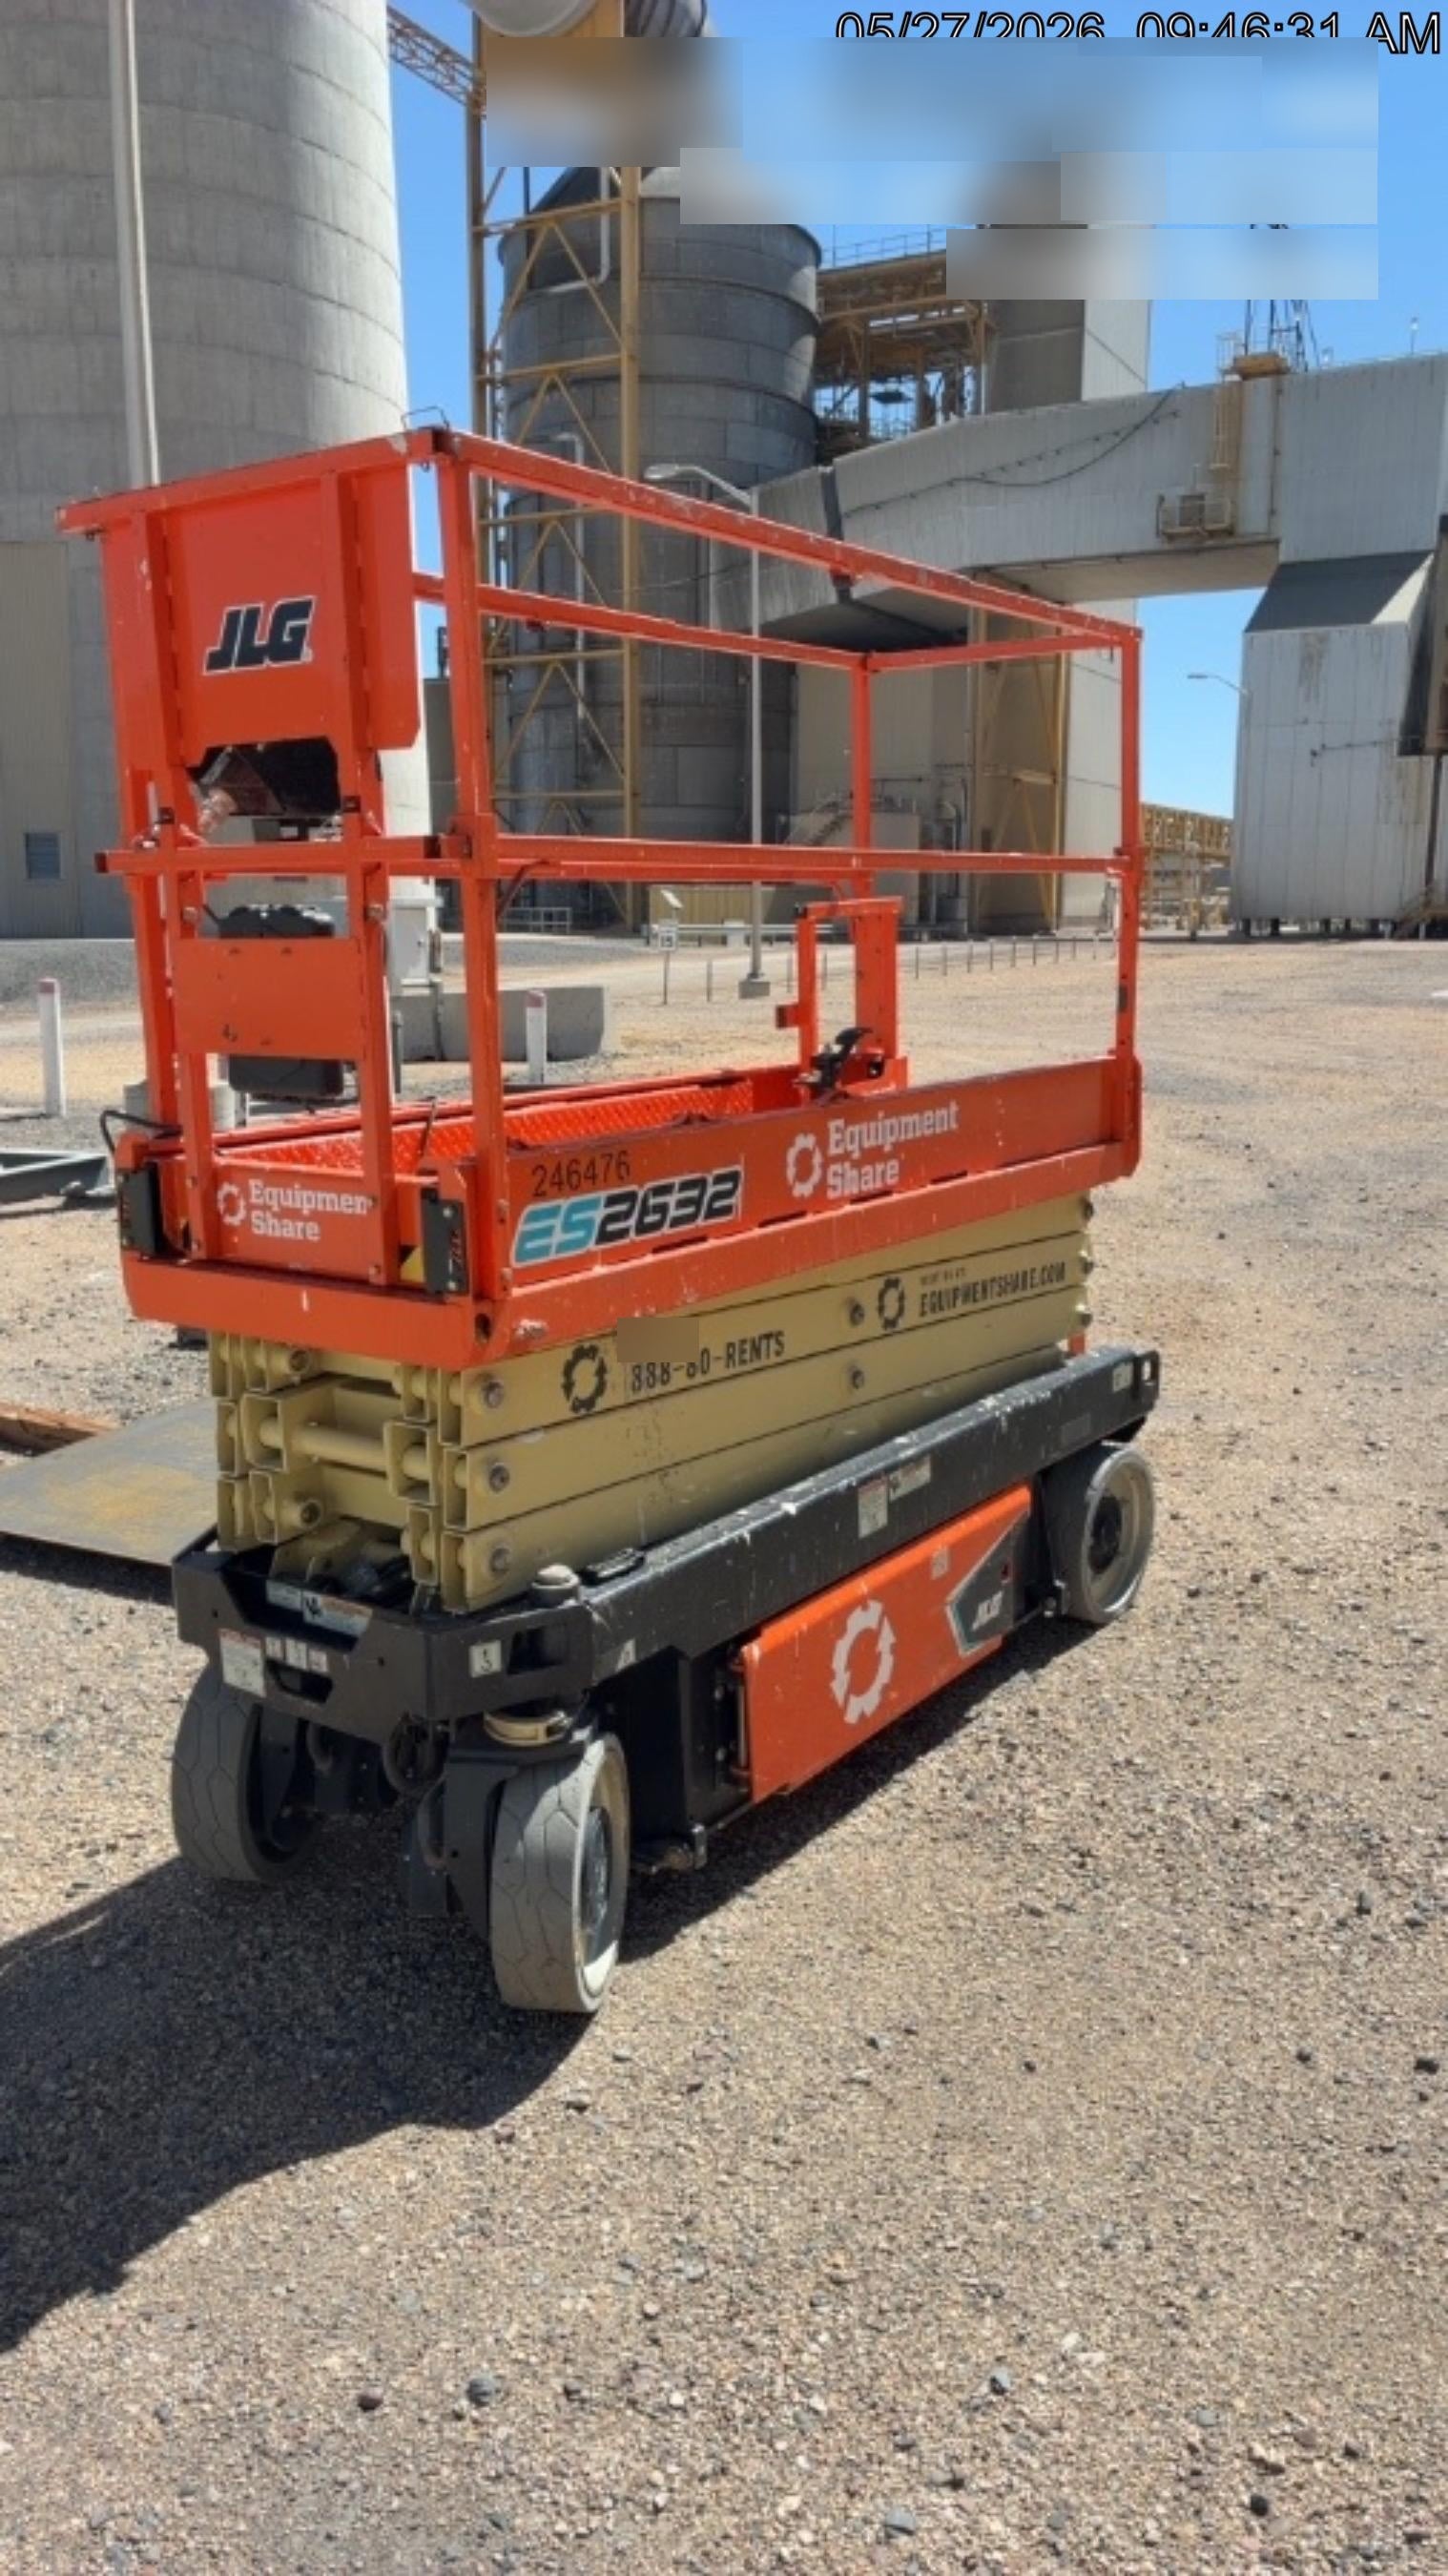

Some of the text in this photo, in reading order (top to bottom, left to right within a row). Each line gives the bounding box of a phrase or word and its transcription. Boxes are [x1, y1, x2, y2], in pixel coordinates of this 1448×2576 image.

[204, 596, 316, 674] JLG
[829, 1100, 958, 1159] Equipment
[249, 1178, 373, 1215] Equipmen
[531, 1151, 631, 1198] 246476
[826, 1158, 900, 1202] Share
[251, 1211, 321, 1241] Share
[511, 1165, 743, 1267] ES2632
[919, 1262, 1065, 1318] EQUIPMENTSHARE.COM
